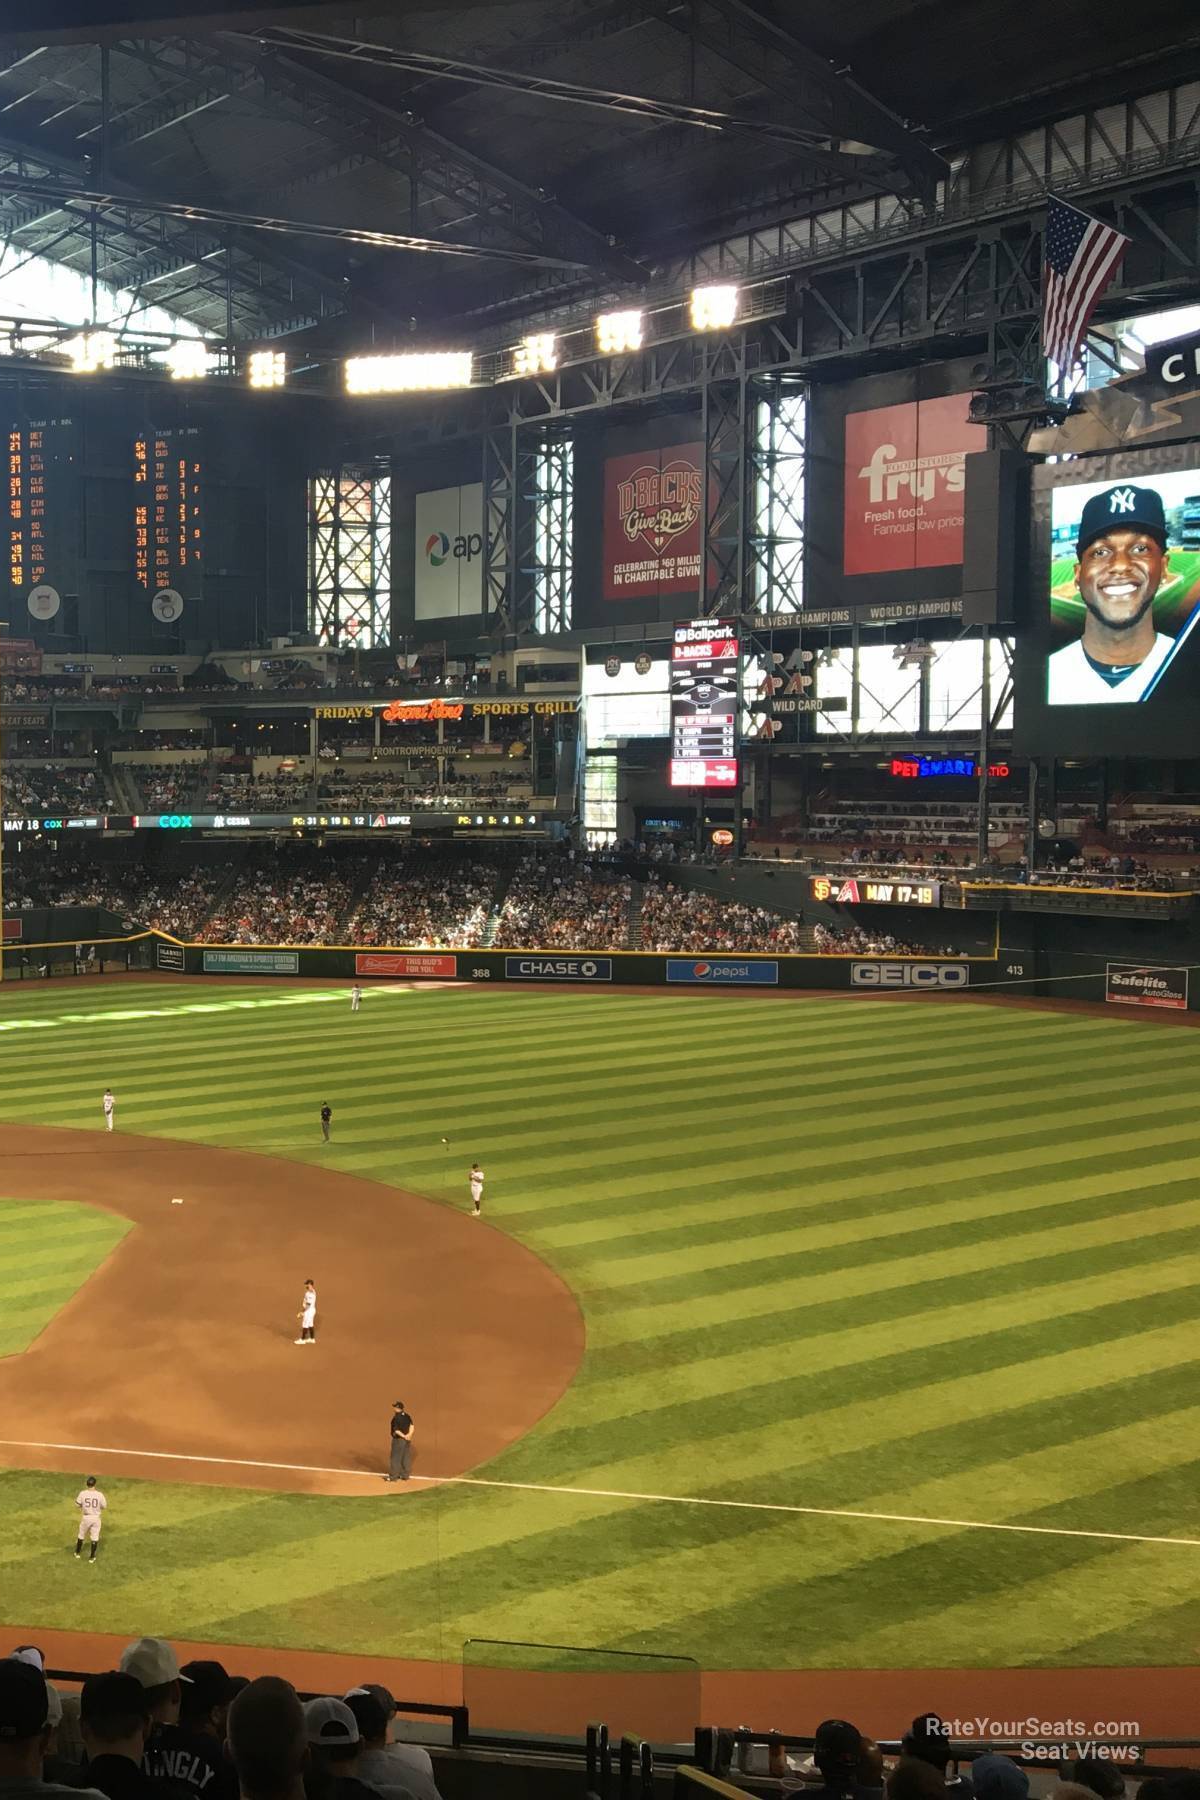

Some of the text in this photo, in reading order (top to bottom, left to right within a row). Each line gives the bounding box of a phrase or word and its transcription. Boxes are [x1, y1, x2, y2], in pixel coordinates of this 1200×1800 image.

[10, 442, 20, 451] 27
[10, 464, 20, 474] 31
[140, 460, 186, 472] 4 0
[886, 454, 964, 473] FOOD STORES
[136, 473, 146, 482] 57
[180, 470, 186, 478] 3
[858, 444, 965, 502] fry's
[10, 487, 20, 496] 31
[180, 482, 186, 491] 3
[180, 491, 186, 500] 7
[180, 504, 186, 512] 2
[864, 505, 927, 523] Fresh food.
[180, 514, 186, 522] 3
[626, 503, 694, 538] Give Back
[180, 526, 186, 534] 7
[874, 516, 965, 536] Famous low price
[180, 535, 186, 544] 5
[12, 544, 22, 554] 49
[180, 548, 186, 556] 0
[12, 554, 22, 562] 57
[614, 555, 701, 574] CELEBRATING $60 MILLIO
[12, 576, 22, 584] 40
[614, 566, 701, 584] IN CHARITABLE GIVIN
[142, 580, 148, 589] 7
[870, 600, 964, 619] WORLD CHAMPIONS
[754, 610, 850, 628] NL WEST CHAMPIONS
[687, 626, 734, 642] Ballpark
[674, 644, 712, 658] D-BACKS
[315, 706, 374, 720] FRIDAY'S
[472, 702, 529, 716] SPORTS
[534, 702, 578, 714] GRILL
[772, 700, 823, 712] WILD CARD
[23, 716, 45, 725] SEATS
[891, 758, 975, 777] PETSMART
[4, 820, 24, 831] MAY
[26, 819, 40, 830] 18
[44, 820, 62, 828] COX
[160, 816, 192, 828] COX
[292, 817, 305, 826] PC:
[307, 817, 316, 825] 31
[331, 817, 341, 825] 19
[354, 816, 364, 824] 12
[388, 816, 411, 824] LOPEZ
[458, 816, 472, 824] PC:
[502, 816, 509, 824] 4
[528, 816, 536, 824] 4
[866, 884, 932, 904] MAY 17-19
[472, 968, 490, 978] 368
[520, 962, 578, 974] CHASE
[712, 966, 750, 978] pepsi
[1006, 965, 1024, 976] 413
[852, 964, 967, 985] GEICO
[1111, 974, 1167, 989] Safelite
[1142, 988, 1182, 998] AutoGlass
[84, 1498, 98, 1508] 50
